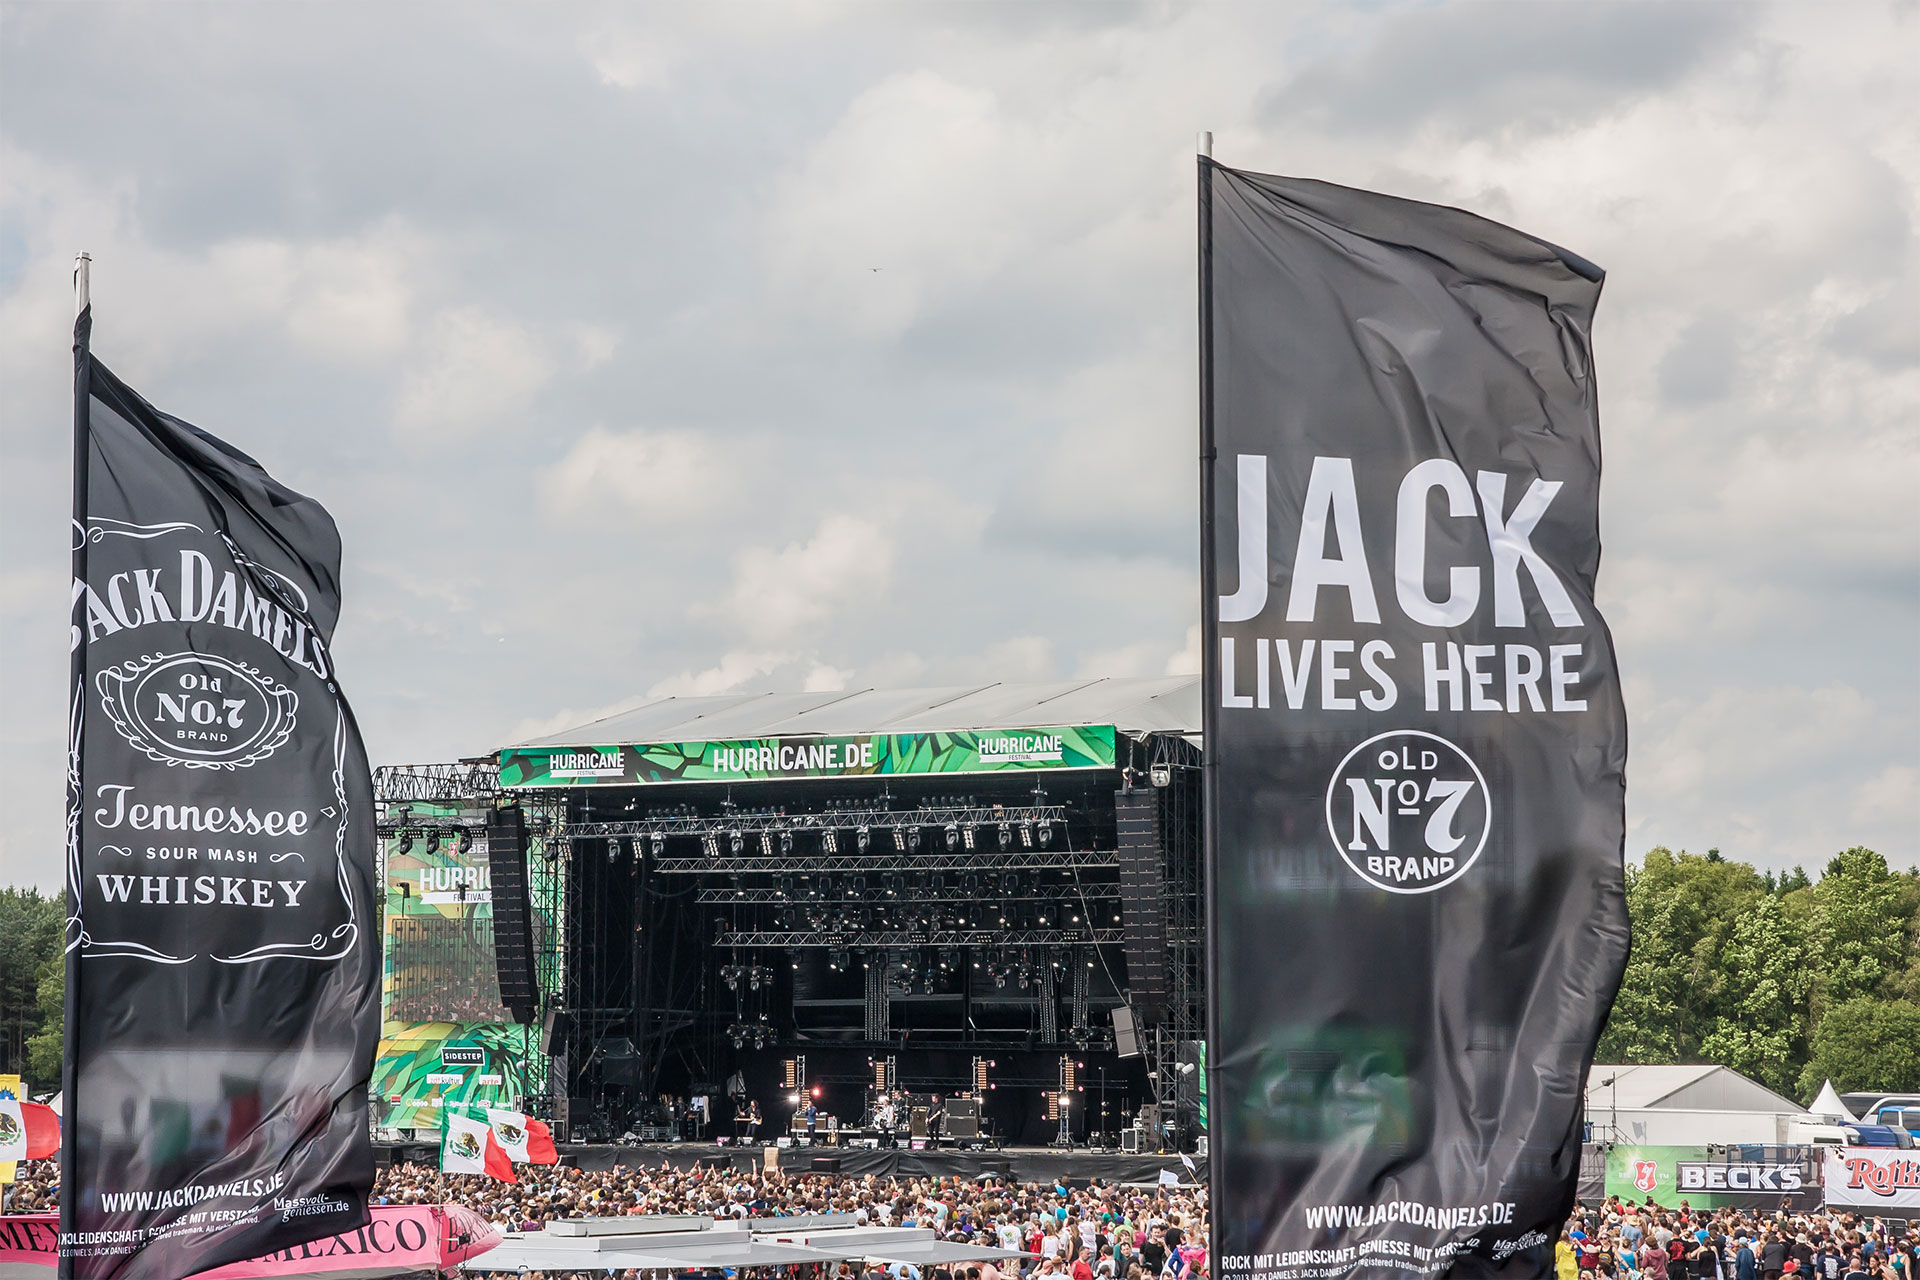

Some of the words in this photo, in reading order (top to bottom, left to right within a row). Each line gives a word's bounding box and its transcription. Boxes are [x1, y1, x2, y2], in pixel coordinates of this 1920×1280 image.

[1219, 454, 1584, 627] JACK
[179, 673, 222, 693] Old
[1221, 637, 1398, 711] LIVES
[1422, 641, 1588, 713] HERE
[176, 730, 228, 742] BRAND
[978, 735, 1063, 754] HURRICANE
[549, 753, 625, 769] HURRICANE
[712, 743, 873, 772] HURRICANE.DE
[1378, 746, 1438, 770] OLD
[94, 784, 308, 836] Tennessee
[146, 847, 198, 860] SOUR
[208, 848, 258, 863] MASH
[1367, 856, 1455, 881] BRAND
[96, 873, 307, 906] WHISKEY
[1682, 1164, 1802, 1190] BECK'S
[1845, 1157, 1920, 1197] Rolli
[101, 1171, 284, 1213] WWW.JACKDANIELS.DE
[189, 1212, 208, 1224] MIT
[1305, 1201, 1516, 1230] WWW.JACKDANIELS.DE
[1222, 1255, 1251, 1269] ROCK
[1254, 1254, 1273, 1269] MIT
[1276, 1247, 1357, 1267] LEIDENSCHAFT.
[1359, 1240, 1411, 1256] GENIESSE
[1413, 1245, 1433, 1261] MIT
[1301, 1268, 1318, 1278] JACK
[1358, 1257, 1393, 1267] registered
[1431, 1262, 1440, 1272] All
